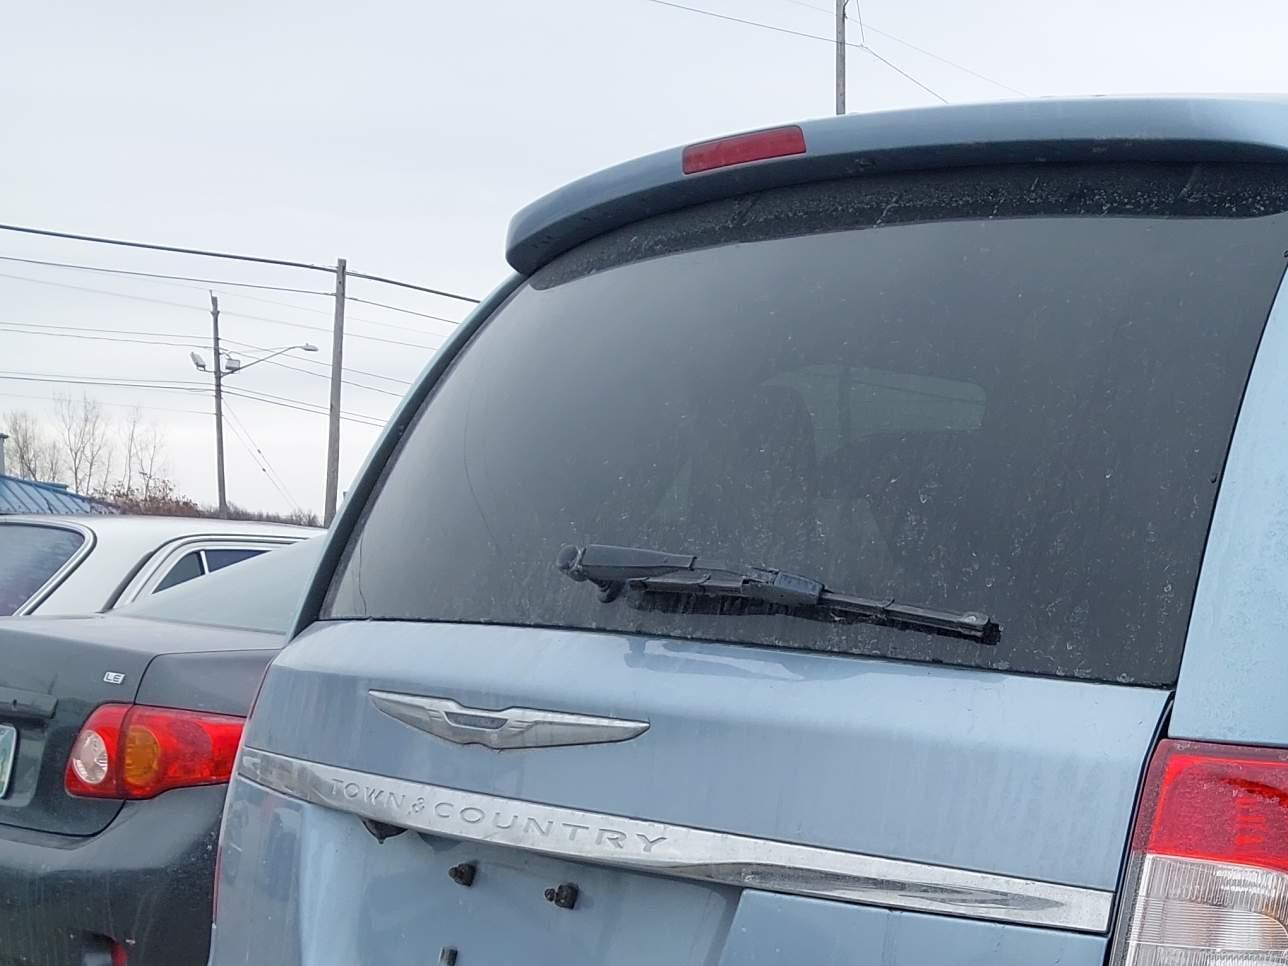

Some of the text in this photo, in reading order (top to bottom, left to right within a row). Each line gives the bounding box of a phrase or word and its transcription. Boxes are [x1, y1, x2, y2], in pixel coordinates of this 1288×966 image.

[104, 672, 122, 683] LE
[330, 778, 668, 853] TOWN & COUNTRY
